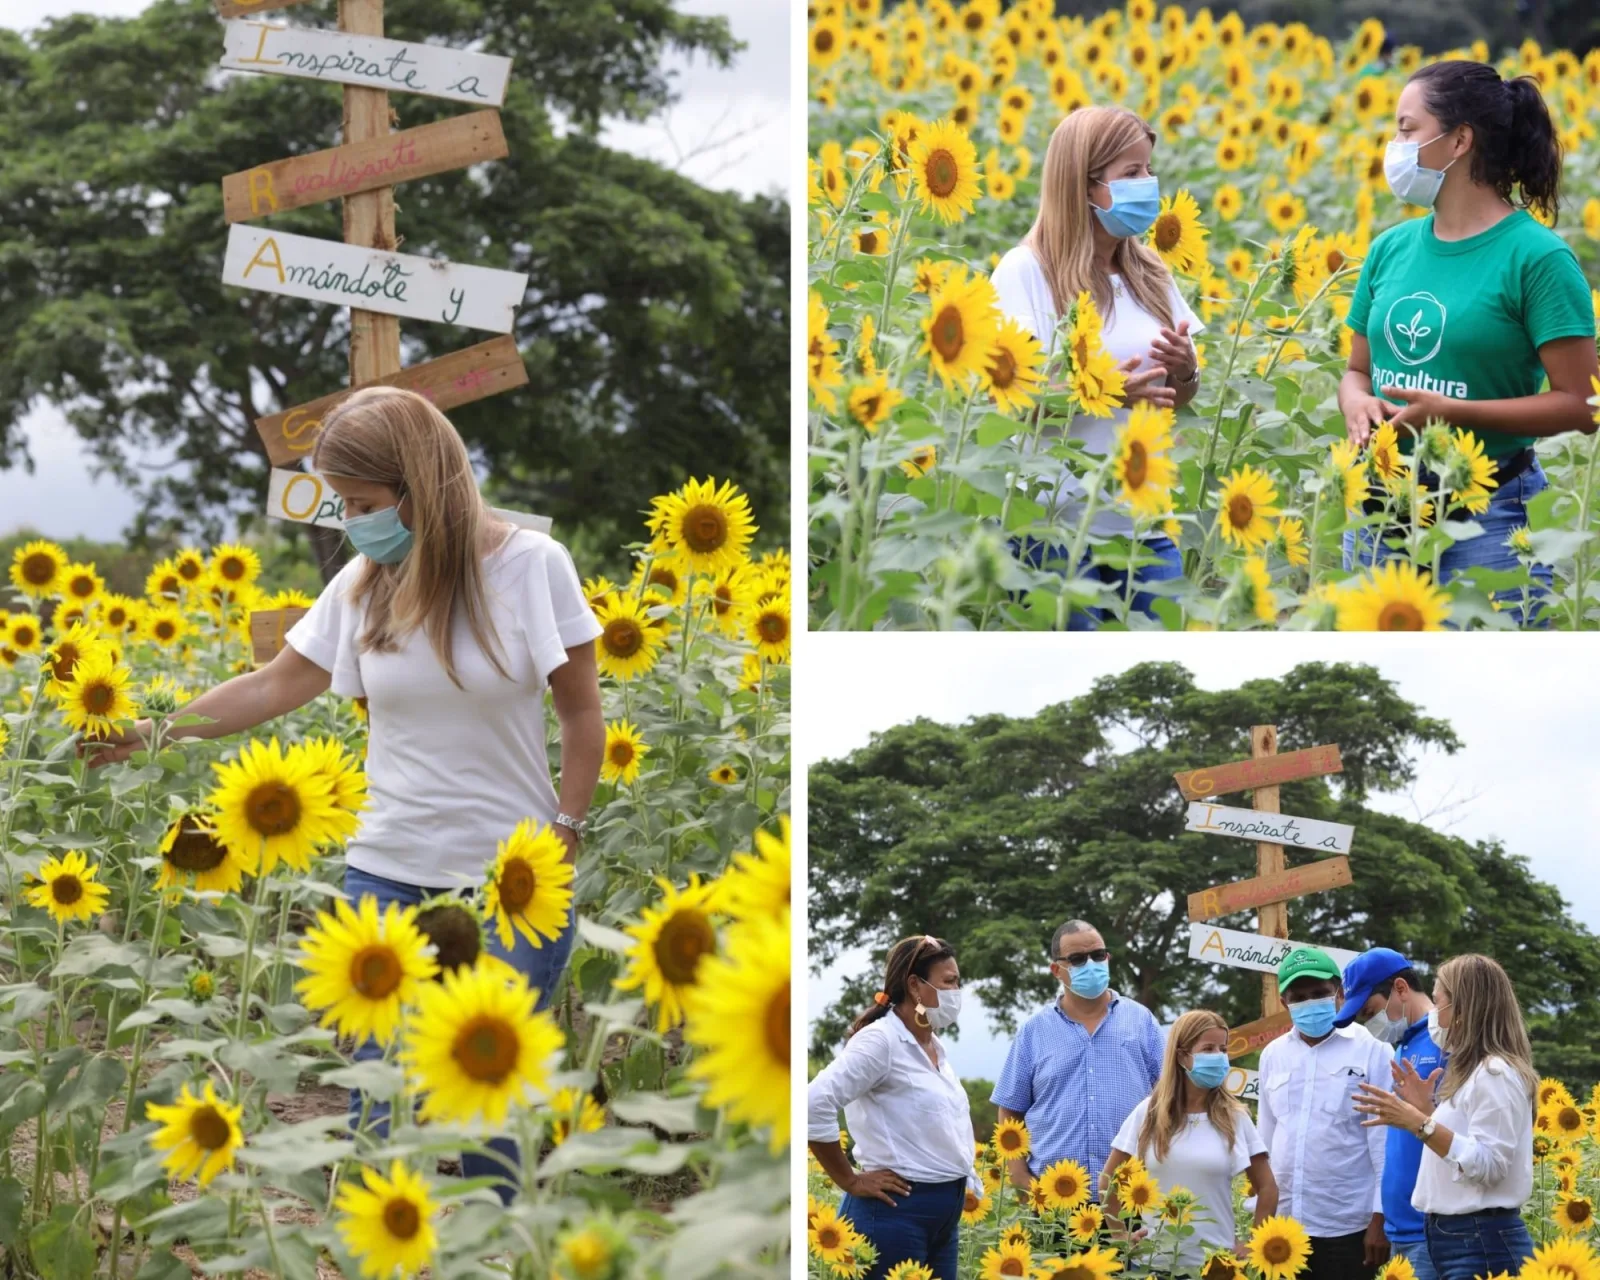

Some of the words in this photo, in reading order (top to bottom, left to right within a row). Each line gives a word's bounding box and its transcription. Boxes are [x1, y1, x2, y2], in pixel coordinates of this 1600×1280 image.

[238, 23, 426, 90] Inspirate
[446, 76, 488, 98] a
[243, 236, 414, 302] Amándote
[442, 287, 465, 324] y
[1195, 804, 1305, 845] Inspirate
[1317, 836, 1341, 850] a
